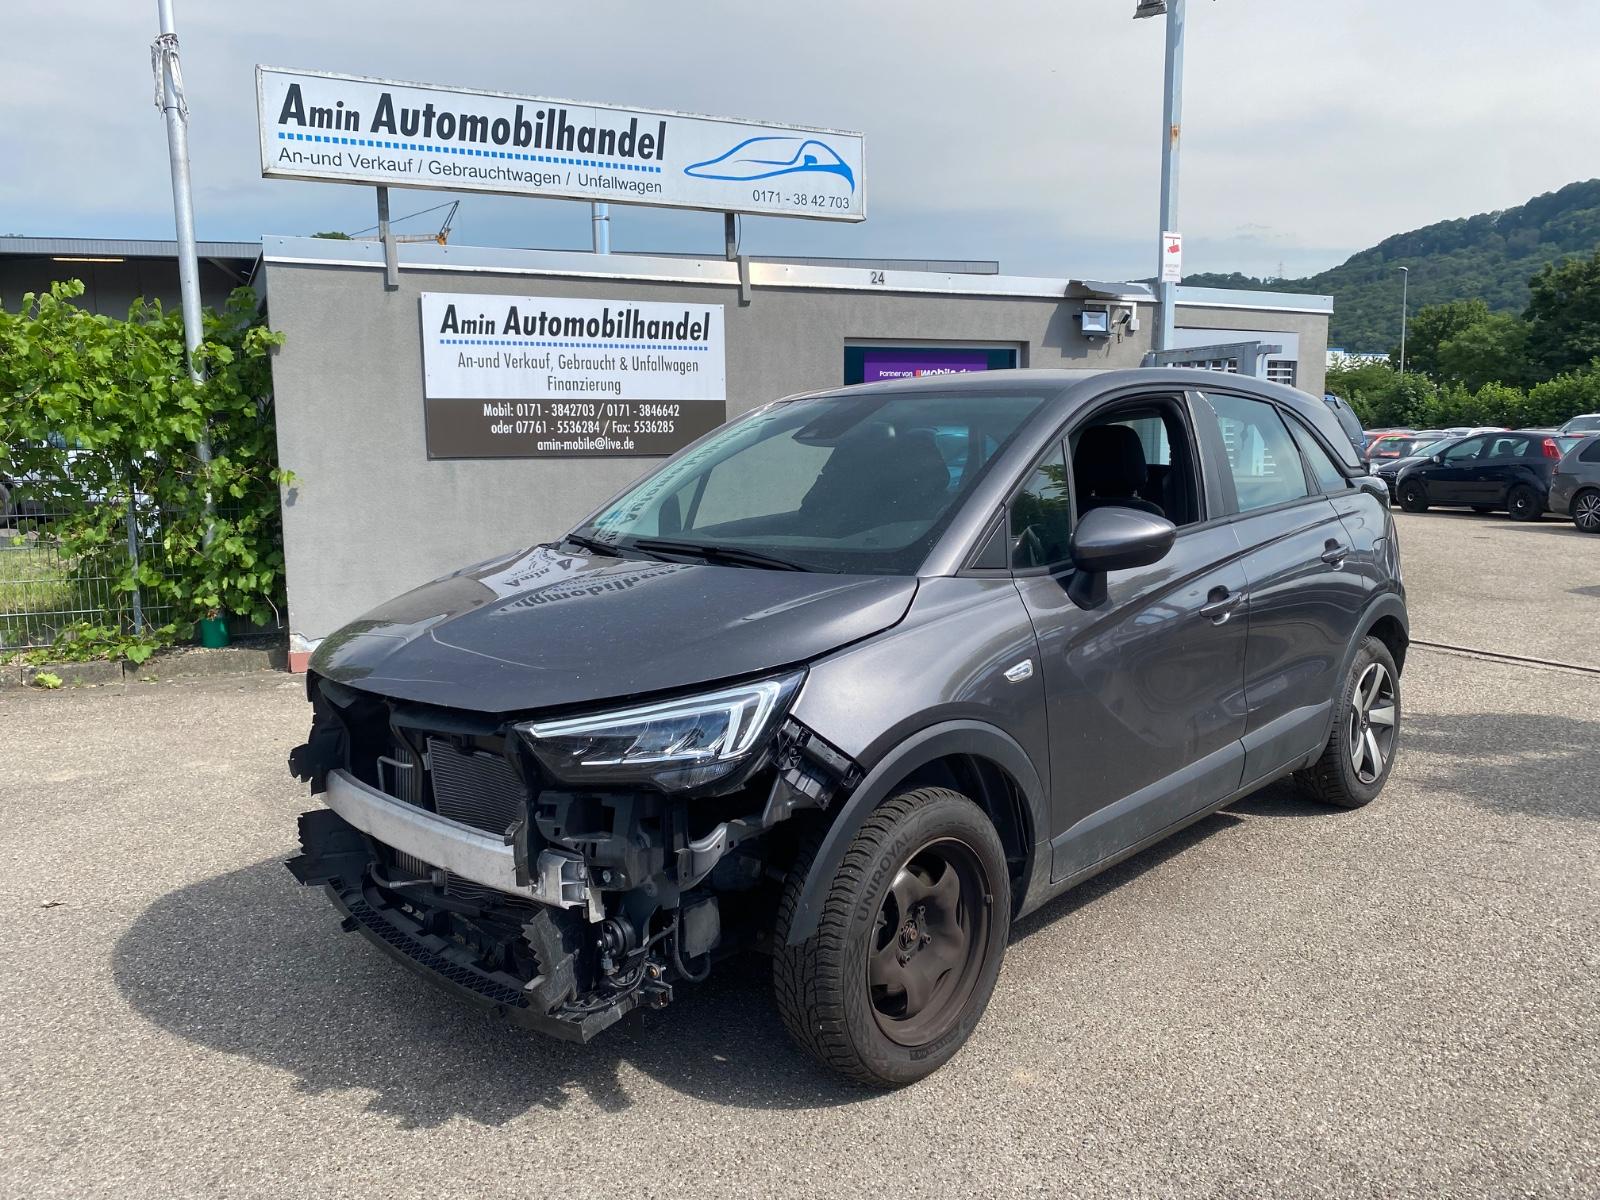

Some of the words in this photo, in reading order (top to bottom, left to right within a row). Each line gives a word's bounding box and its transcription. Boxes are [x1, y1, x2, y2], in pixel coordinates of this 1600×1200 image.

[278, 83, 360, 132] Amin
[370, 92, 666, 160] Automobilhandel
[278, 147, 342, 167] An-und
[347, 152, 413, 173] Verkauf
[417, 160, 423, 174] /
[428, 161, 561, 187] Gebrauchtwagen
[565, 172, 571, 186] /
[578, 174, 662, 195] Unfallwagen
[752, 189, 781, 203] 0171
[793, 193, 808, 206] 38
[811, 194, 826, 207] 42
[828, 196, 850, 209] 703
[871, 271, 885, 285] 24
[439, 304, 496, 335] Amin
[502, 305, 710, 341] Automobilhandel
[457, 352, 501, 369] An-und
[503, 353, 554, 372] Verkauf,
[558, 354, 616, 371] Gebraucht
[619, 357, 629, 371] &
[631, 356, 699, 375] Unfallwagen
[902, 370, 913, 378] von
[920, 368, 970, 377] mobil
[547, 375, 622, 395] Finanzierung
[483, 403, 514, 417] Mobil:
[516, 403, 541, 417] 0171
[551, 403, 595, 417] 3842703
[596, 402, 604, 419] /
[606, 403, 630, 417] 0171
[639, 403, 680, 417] 3846642
[490, 420, 513, 434] oder
[516, 420, 547, 434] 07761
[557, 420, 600, 434] 5536284
[602, 419, 610, 436] /
[612, 420, 631, 433] Fax:
[633, 420, 674, 433] 5536285
[537, 437, 635, 451] amin-mobile@live.de
[857, 831, 913, 922] UNIROYAL
